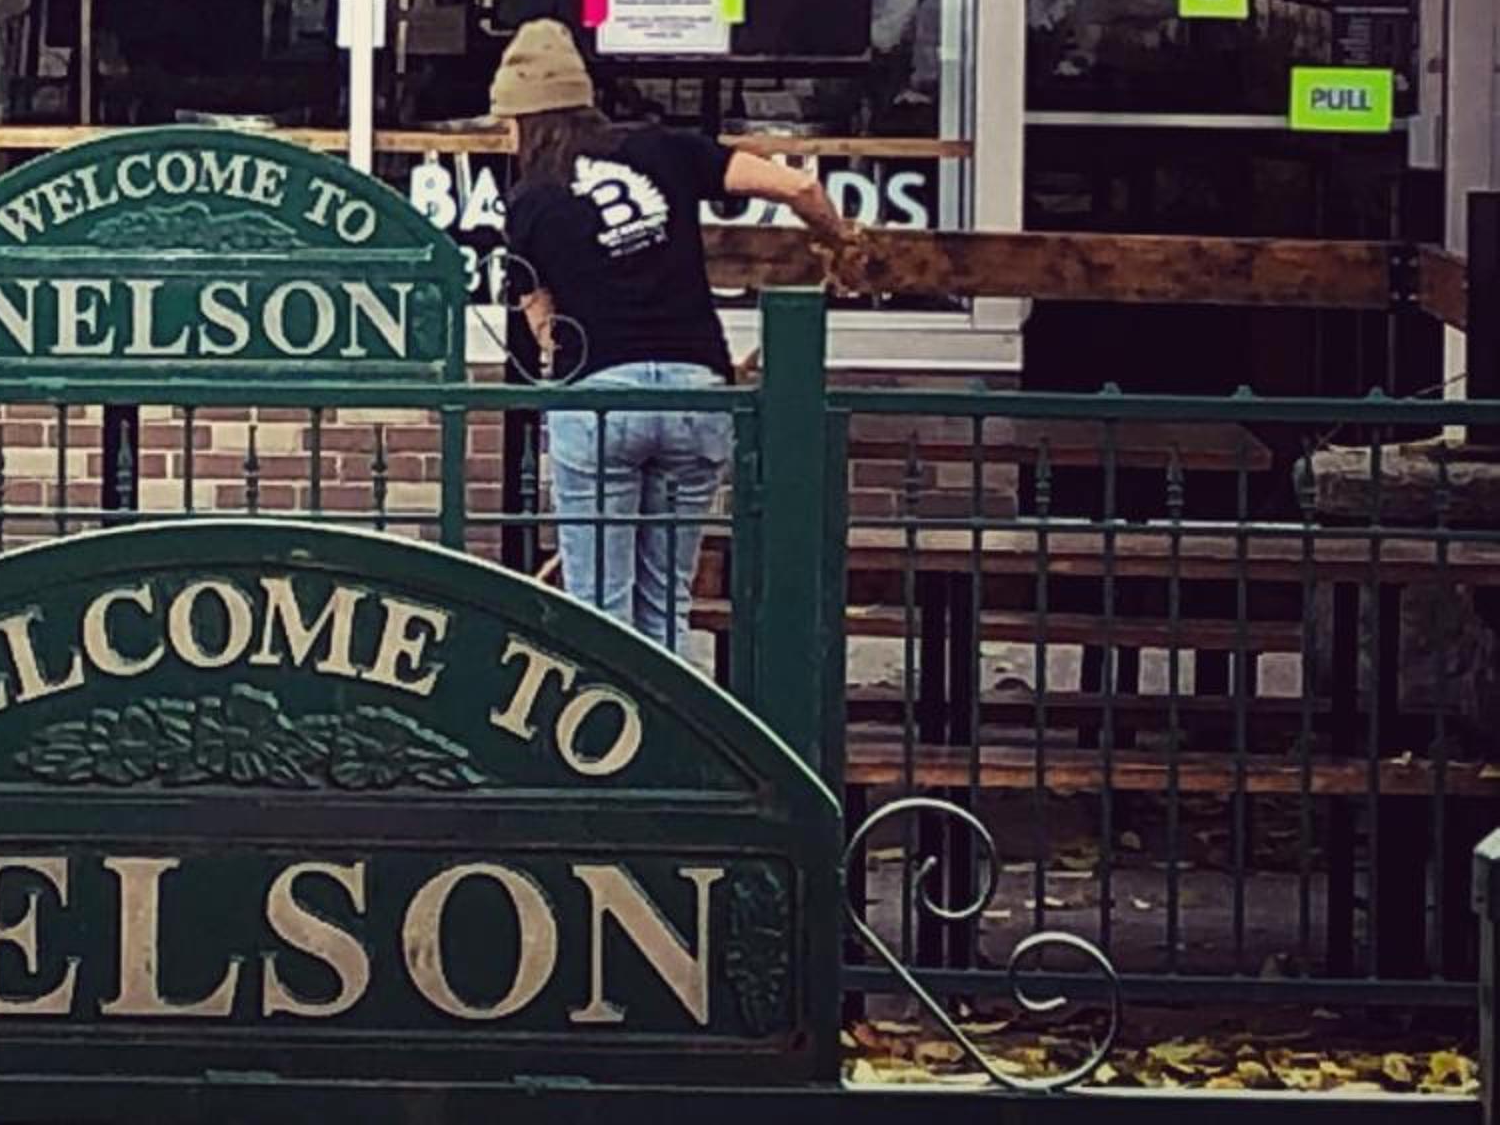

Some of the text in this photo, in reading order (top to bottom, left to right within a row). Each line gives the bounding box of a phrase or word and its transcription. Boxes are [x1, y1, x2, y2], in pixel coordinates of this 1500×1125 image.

[1310, 87, 1372, 111] PULL
[308, 176, 377, 243] TO
[489, 637, 644, 777] TO
